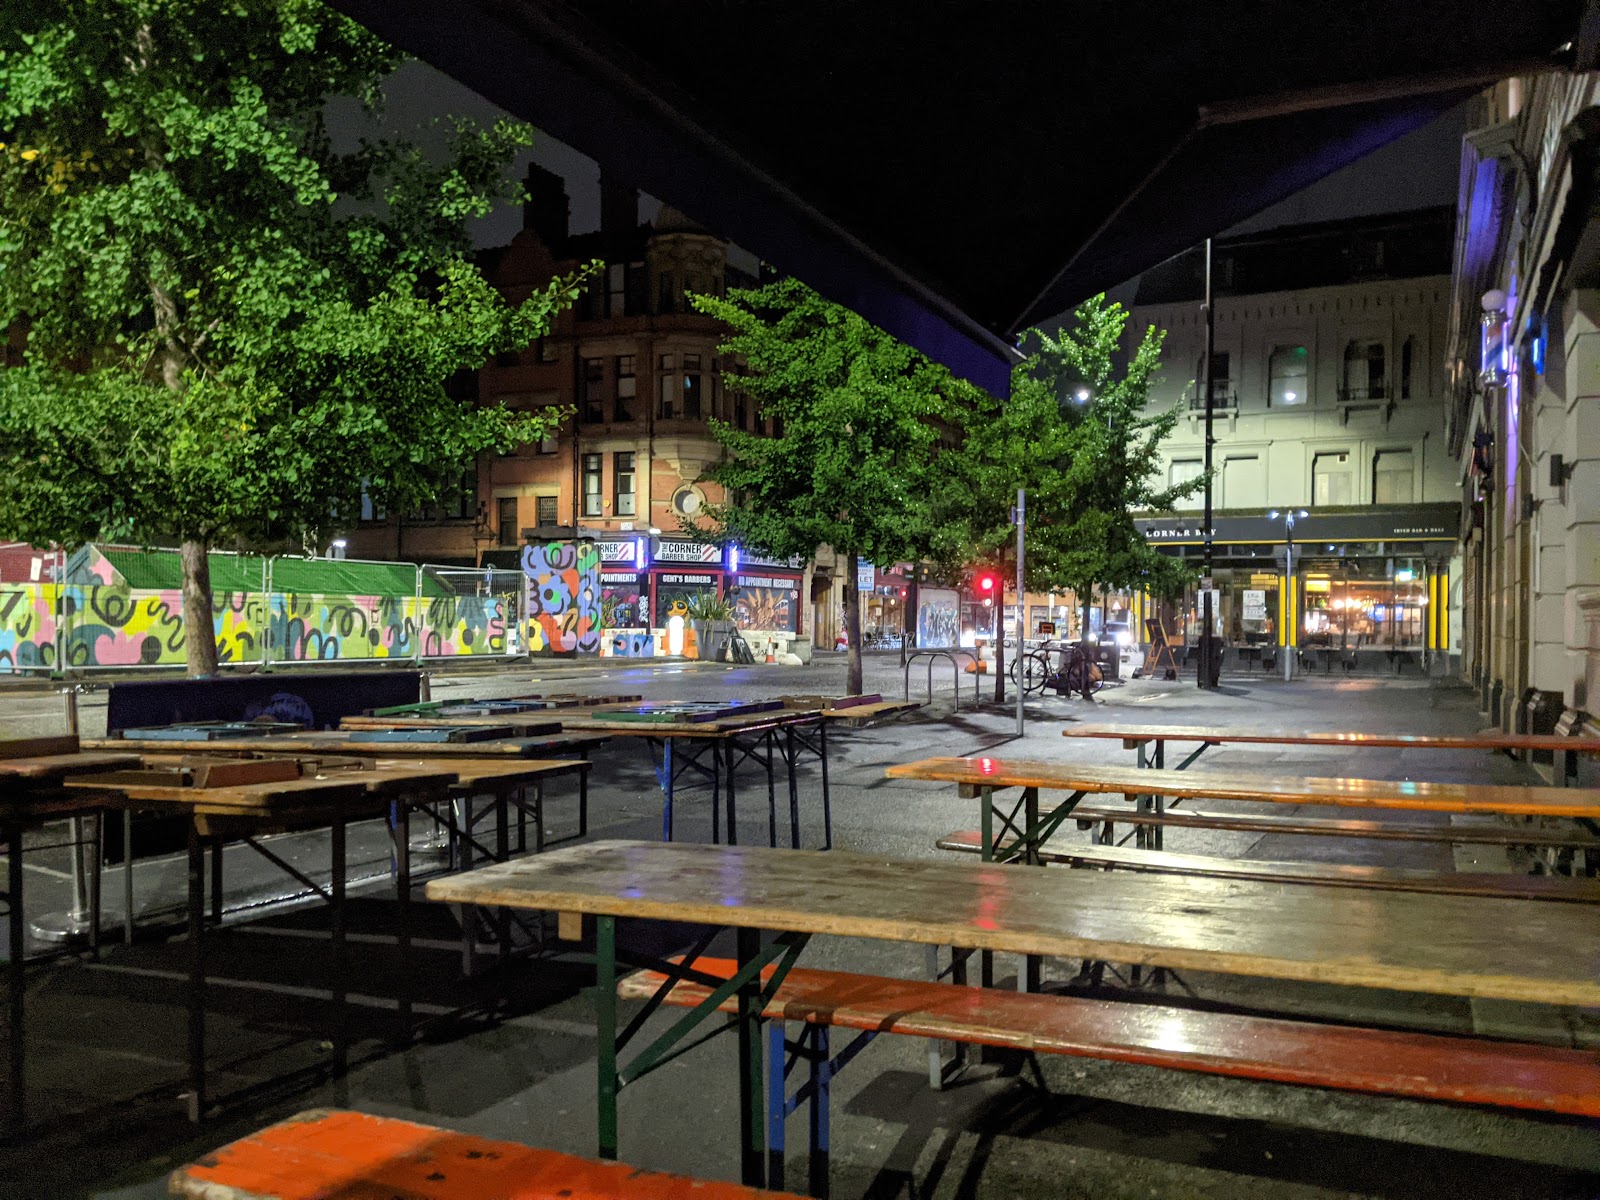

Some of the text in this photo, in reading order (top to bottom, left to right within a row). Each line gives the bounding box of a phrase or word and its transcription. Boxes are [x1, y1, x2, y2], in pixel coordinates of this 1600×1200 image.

[669, 543, 702, 554] CORNER
[662, 574, 711, 583] GENT'S BARBERS
[746, 576, 773, 588] APPOINTMENT
[773, 578, 795, 589] NECESSARY
